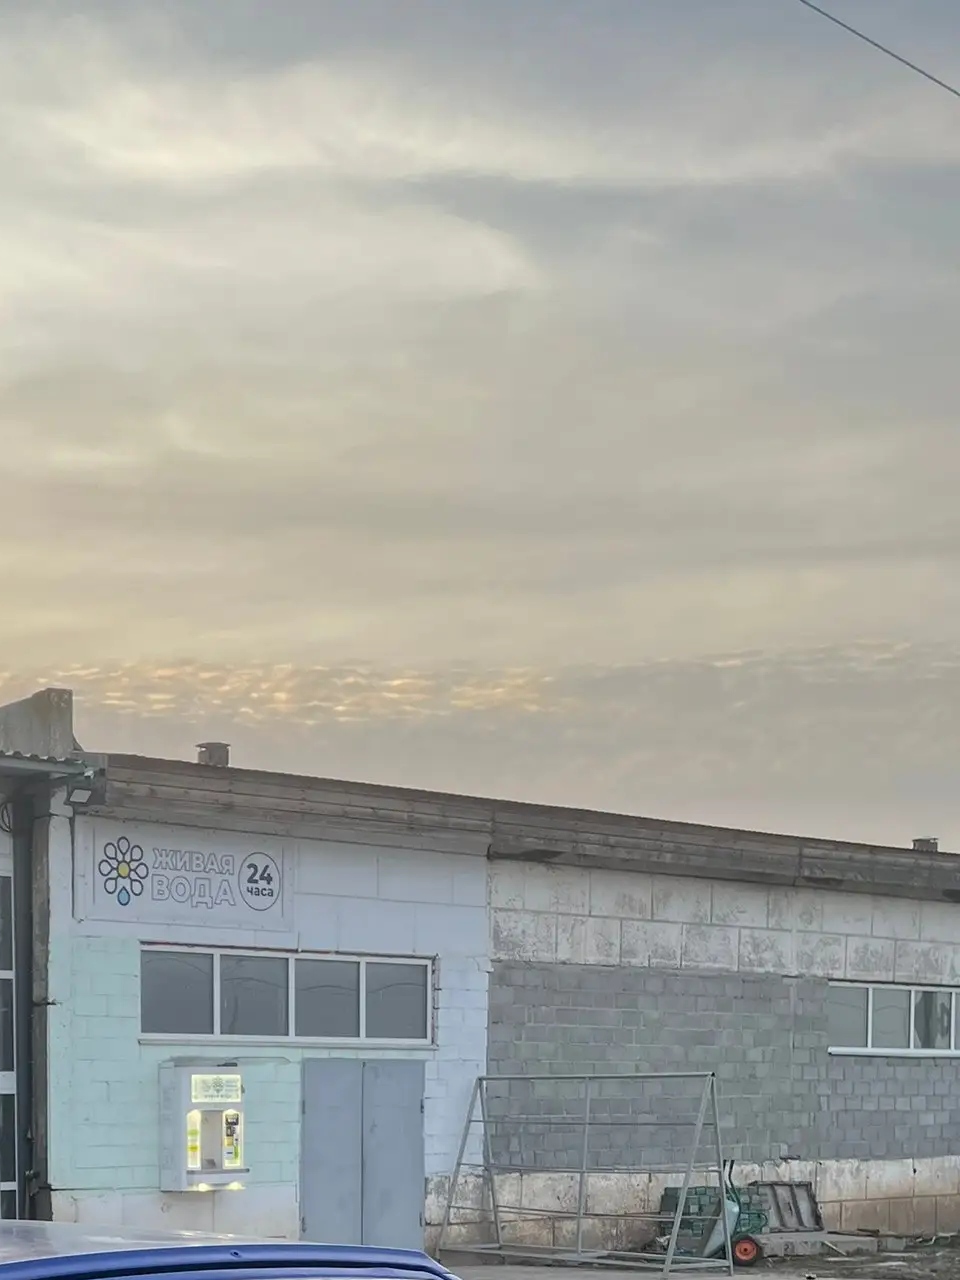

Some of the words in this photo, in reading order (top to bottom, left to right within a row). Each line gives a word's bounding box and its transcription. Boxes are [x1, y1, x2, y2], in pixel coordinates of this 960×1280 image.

[152, 849, 234, 875] ЖИВАЯ
[247, 863, 273, 885] 24
[151, 875, 236, 908] ВОДА
[247, 886, 274, 898] часа
